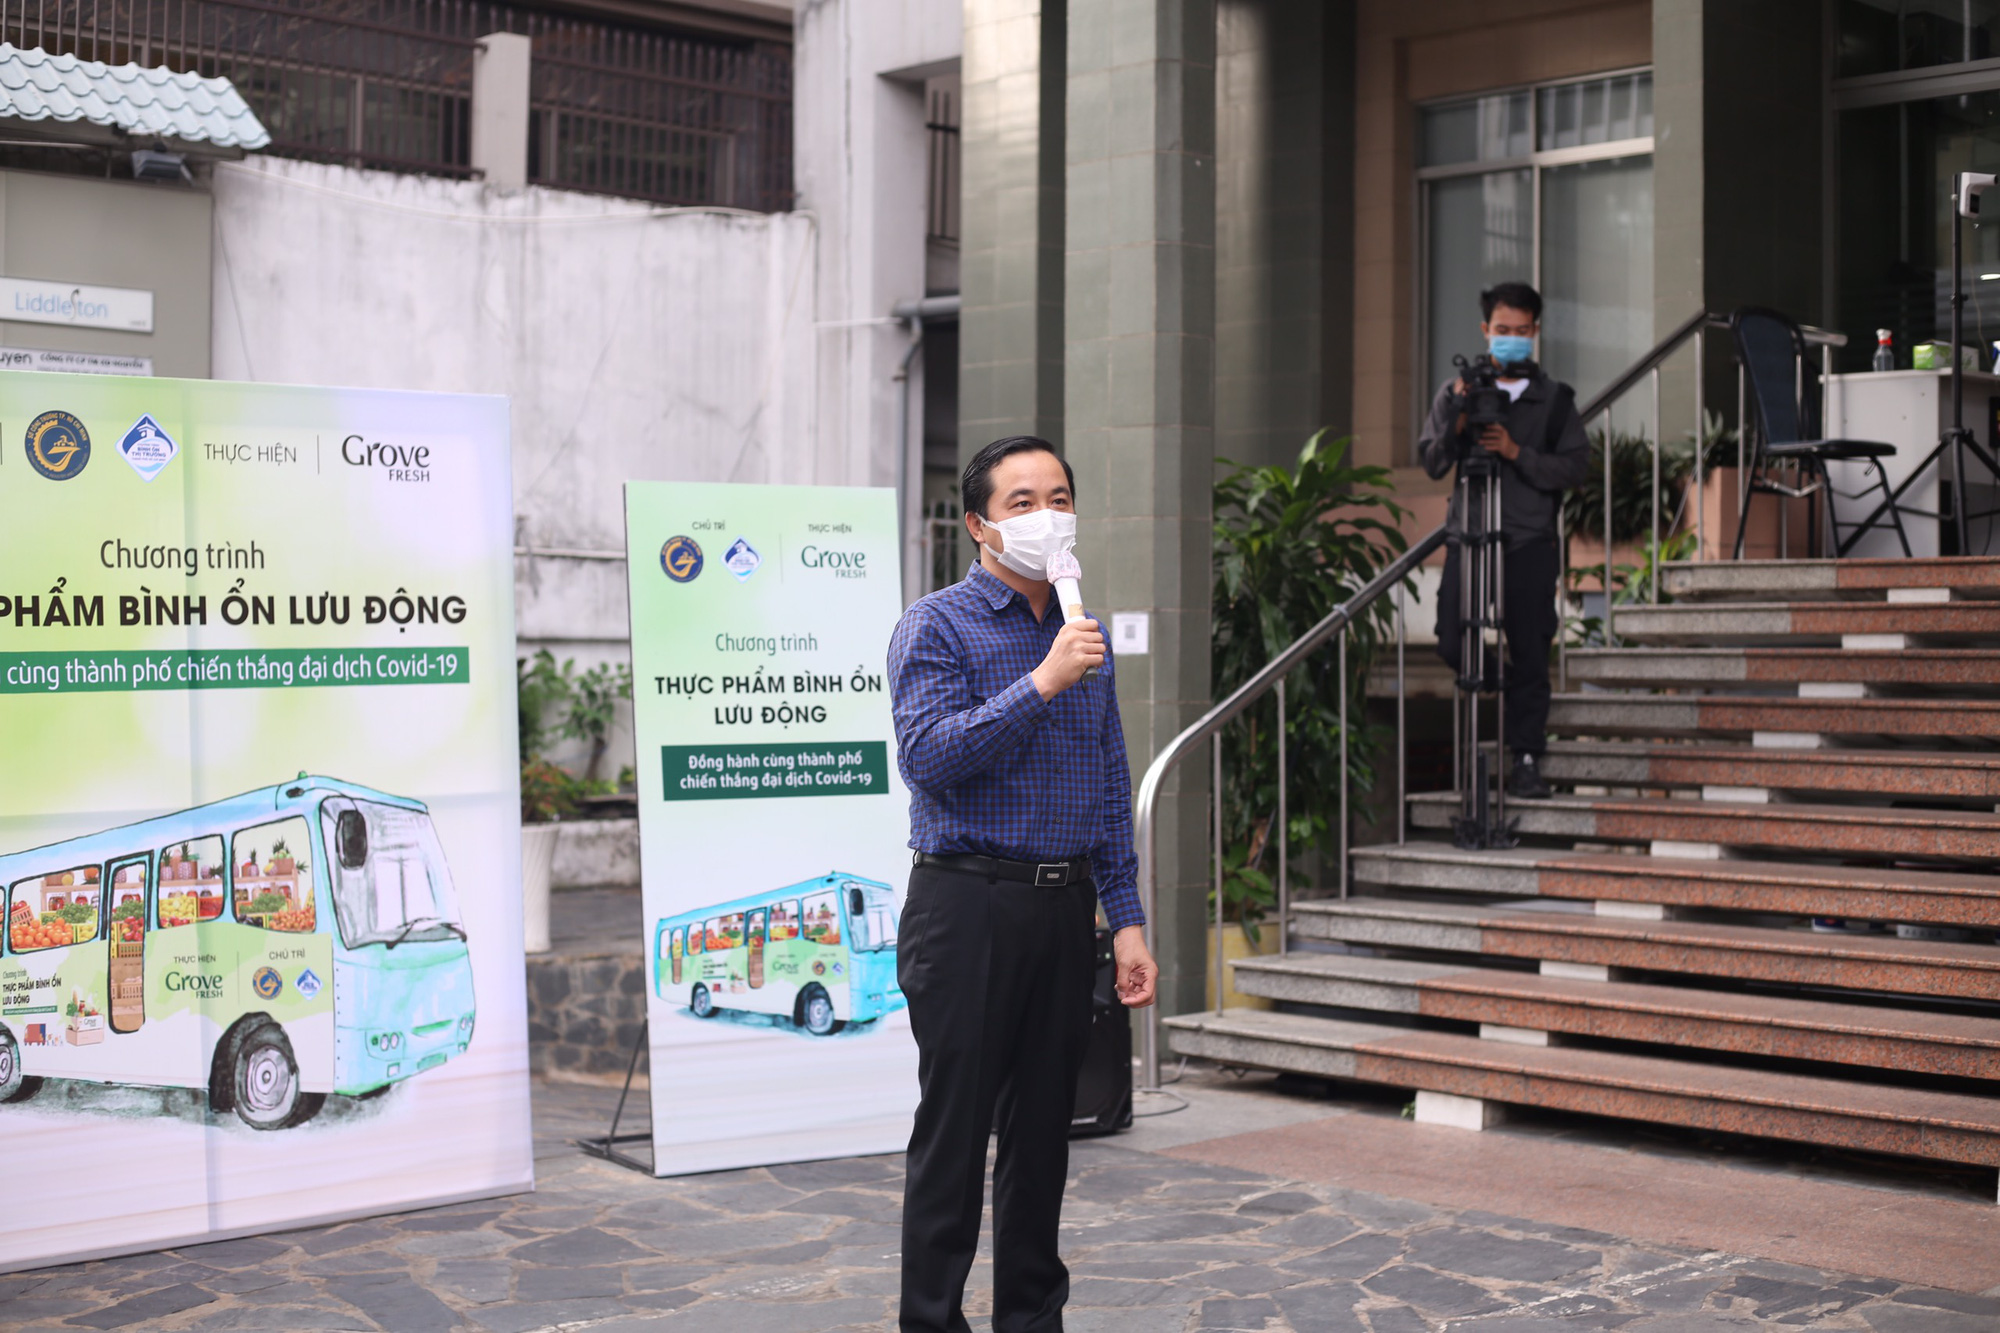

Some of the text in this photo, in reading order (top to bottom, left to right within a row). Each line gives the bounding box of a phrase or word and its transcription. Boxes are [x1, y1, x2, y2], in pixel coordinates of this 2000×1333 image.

[204, 442, 297, 466] THỰC HIỆN
[341, 434, 430, 468] Grove
[389, 469, 430, 482] FRESH
[808, 523, 852, 534] THỰC HIỆN
[100, 539, 266, 576] Chương trình
[801, 545, 866, 568] Grove
[835, 569, 866, 579] FRESH
[119, 586, 207, 626] BÌNH
[221, 577, 275, 626] ỔN
[289, 591, 350, 625] LƯU
[363, 587, 467, 633] ĐỘNG
[715, 632, 818, 656] Chương trình
[7, 653, 457, 690] cùng thành phố chiến thắng đại dịch Covid-19
[654, 664, 882, 700] THỰC PHẨM BÌNH ỔN
[714, 701, 827, 729] LƯU ĐỘNG
[688, 750, 862, 772] Đồng hành cùng thành phố
[680, 770, 873, 790] chiến thắng đại dịch Covid-19
[174, 954, 216, 964] THỰC HIỆN
[269, 948, 306, 960] CHỦ TRÌ
[36, 978, 50, 990] BÌNH
[165, 971, 223, 991] Grove
[196, 990, 223, 999] FRESH
